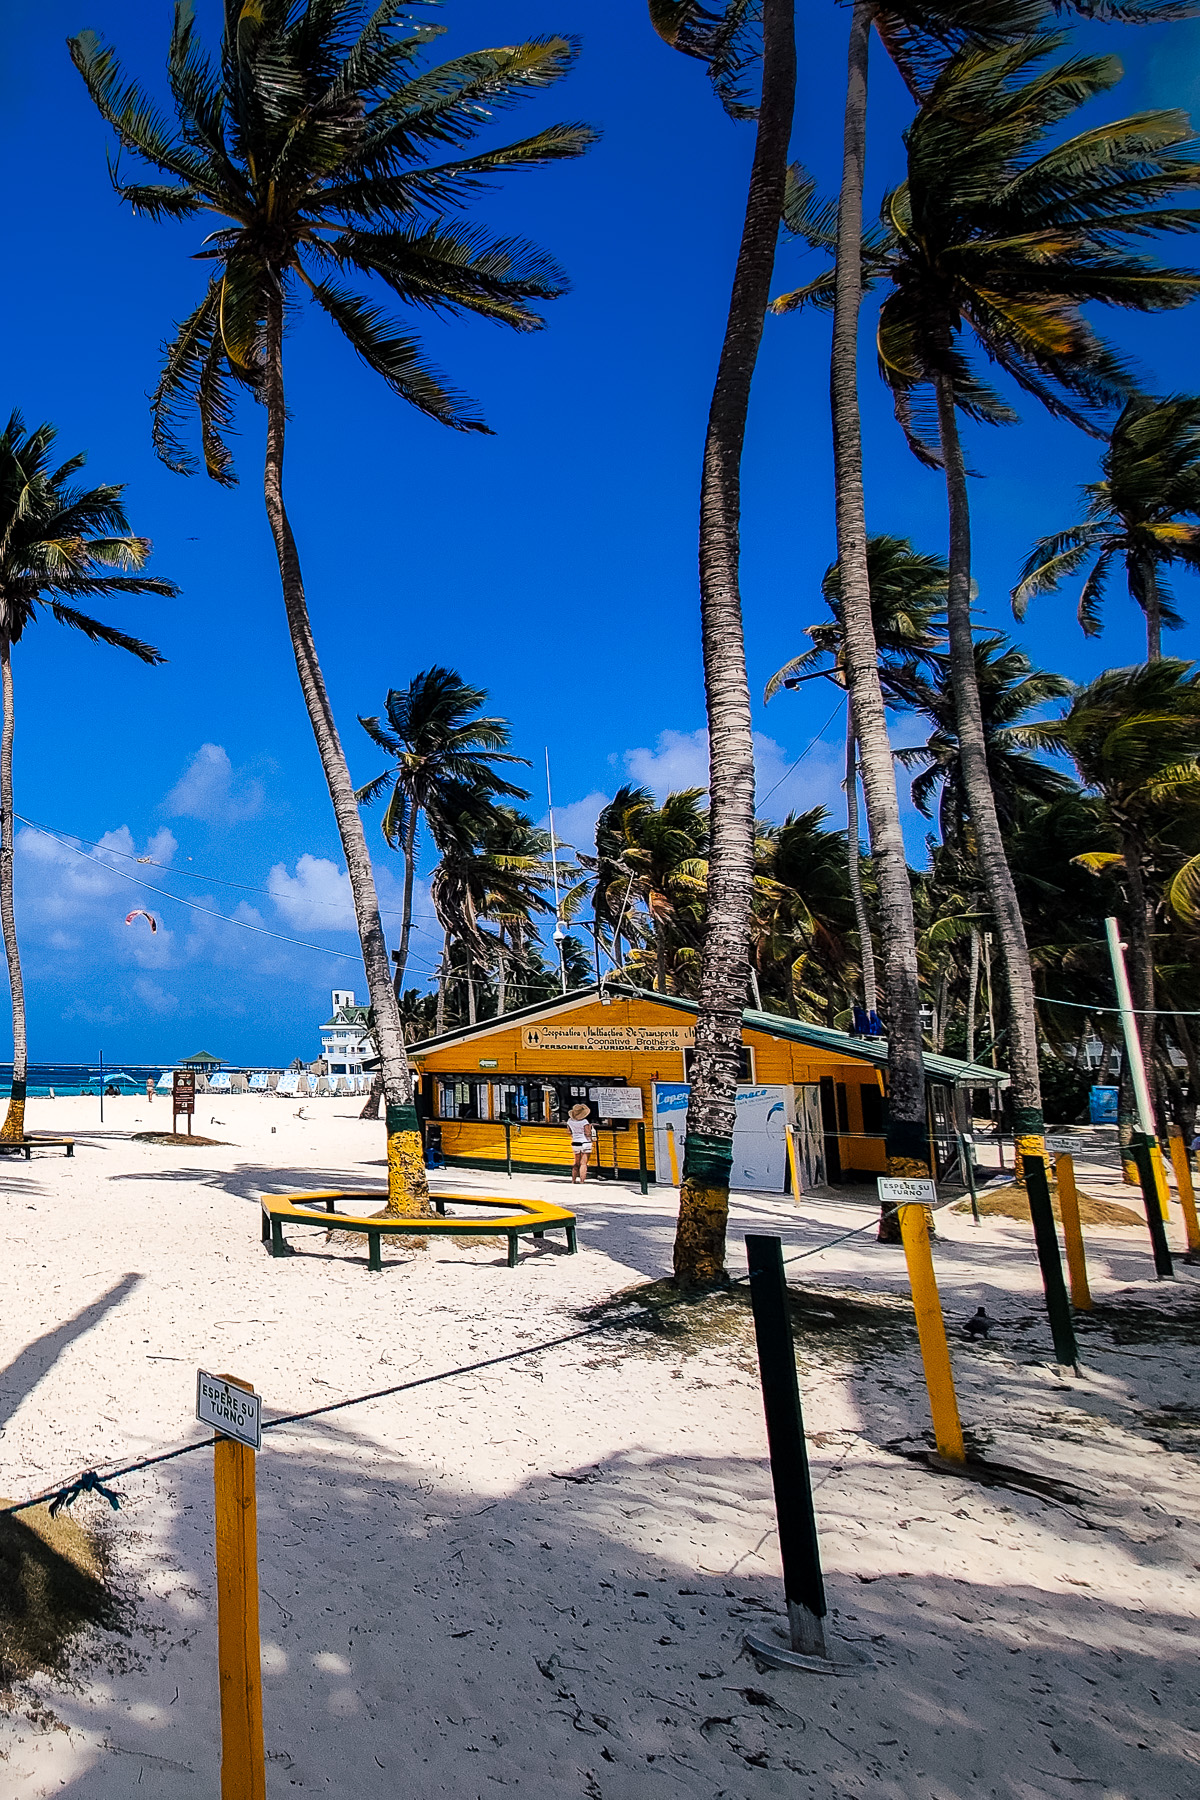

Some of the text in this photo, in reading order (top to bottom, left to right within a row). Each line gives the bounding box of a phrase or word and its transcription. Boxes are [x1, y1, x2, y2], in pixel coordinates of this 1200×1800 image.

[587, 1037, 676, 1046] Coonative Brother's
[656, 1092, 688, 1105] Coper
[735, 1089, 767, 1101] eraco
[202, 1383, 254, 1418] ESPERE SU
[210, 1400, 245, 1427] TURNO
